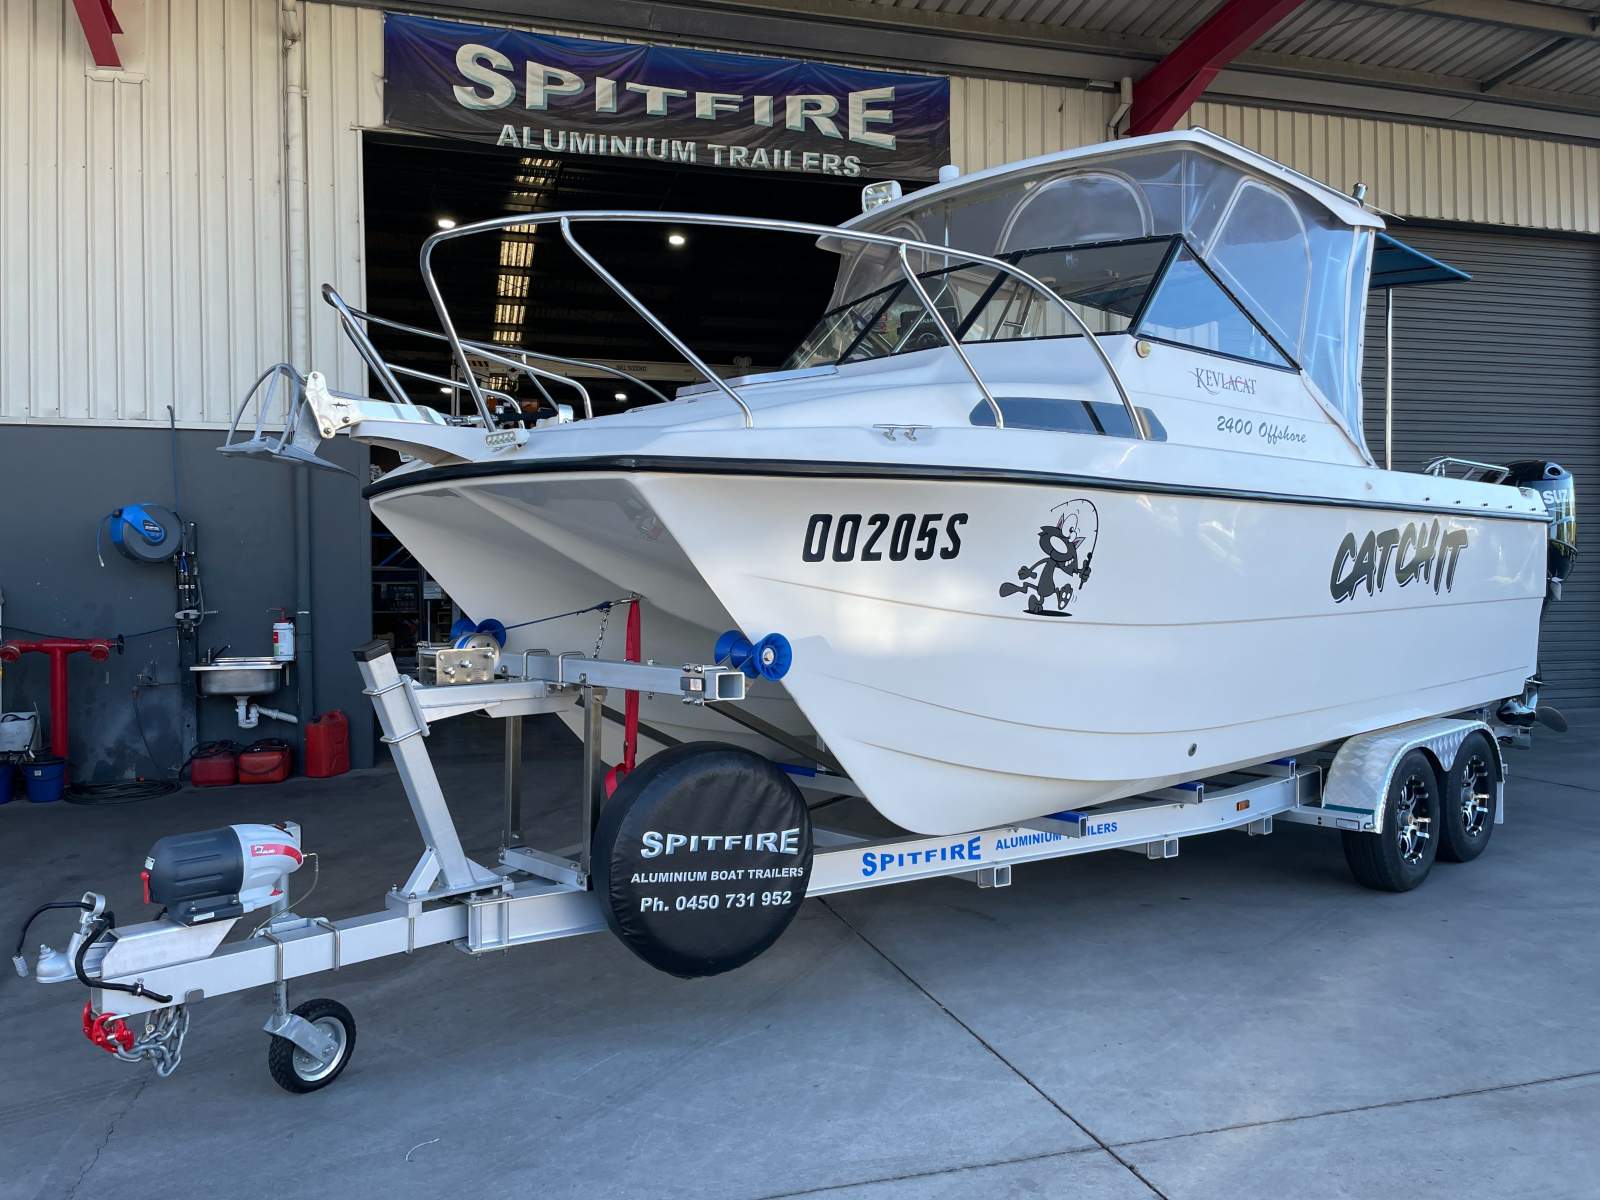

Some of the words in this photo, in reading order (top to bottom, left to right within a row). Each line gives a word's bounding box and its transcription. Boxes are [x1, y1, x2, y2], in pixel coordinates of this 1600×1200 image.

[452, 42, 897, 151] SPITFIRE
[496, 123, 697, 164] ALUMINIUM
[707, 143, 862, 178] TRAILERS
[1190, 367, 1257, 395] KEVLACAT
[1216, 415, 1253, 436] 2400
[1258, 421, 1307, 445] Offshore
[1330, 517, 1468, 603] CATCHIT
[640, 827, 801, 859] SPITFIRE
[862, 835, 982, 877] SPITFIRE
[995, 832, 1062, 851] ALUMINIUM
[630, 871, 708, 884] ALUMINIUM
[710, 869, 745, 882] BOAT
[748, 866, 804, 879] TRAILERS
[640, 896, 670, 913] Ph.
[675, 894, 720, 911] 0450
[725, 892, 756, 909] 731
[761, 890, 793, 906] 952
